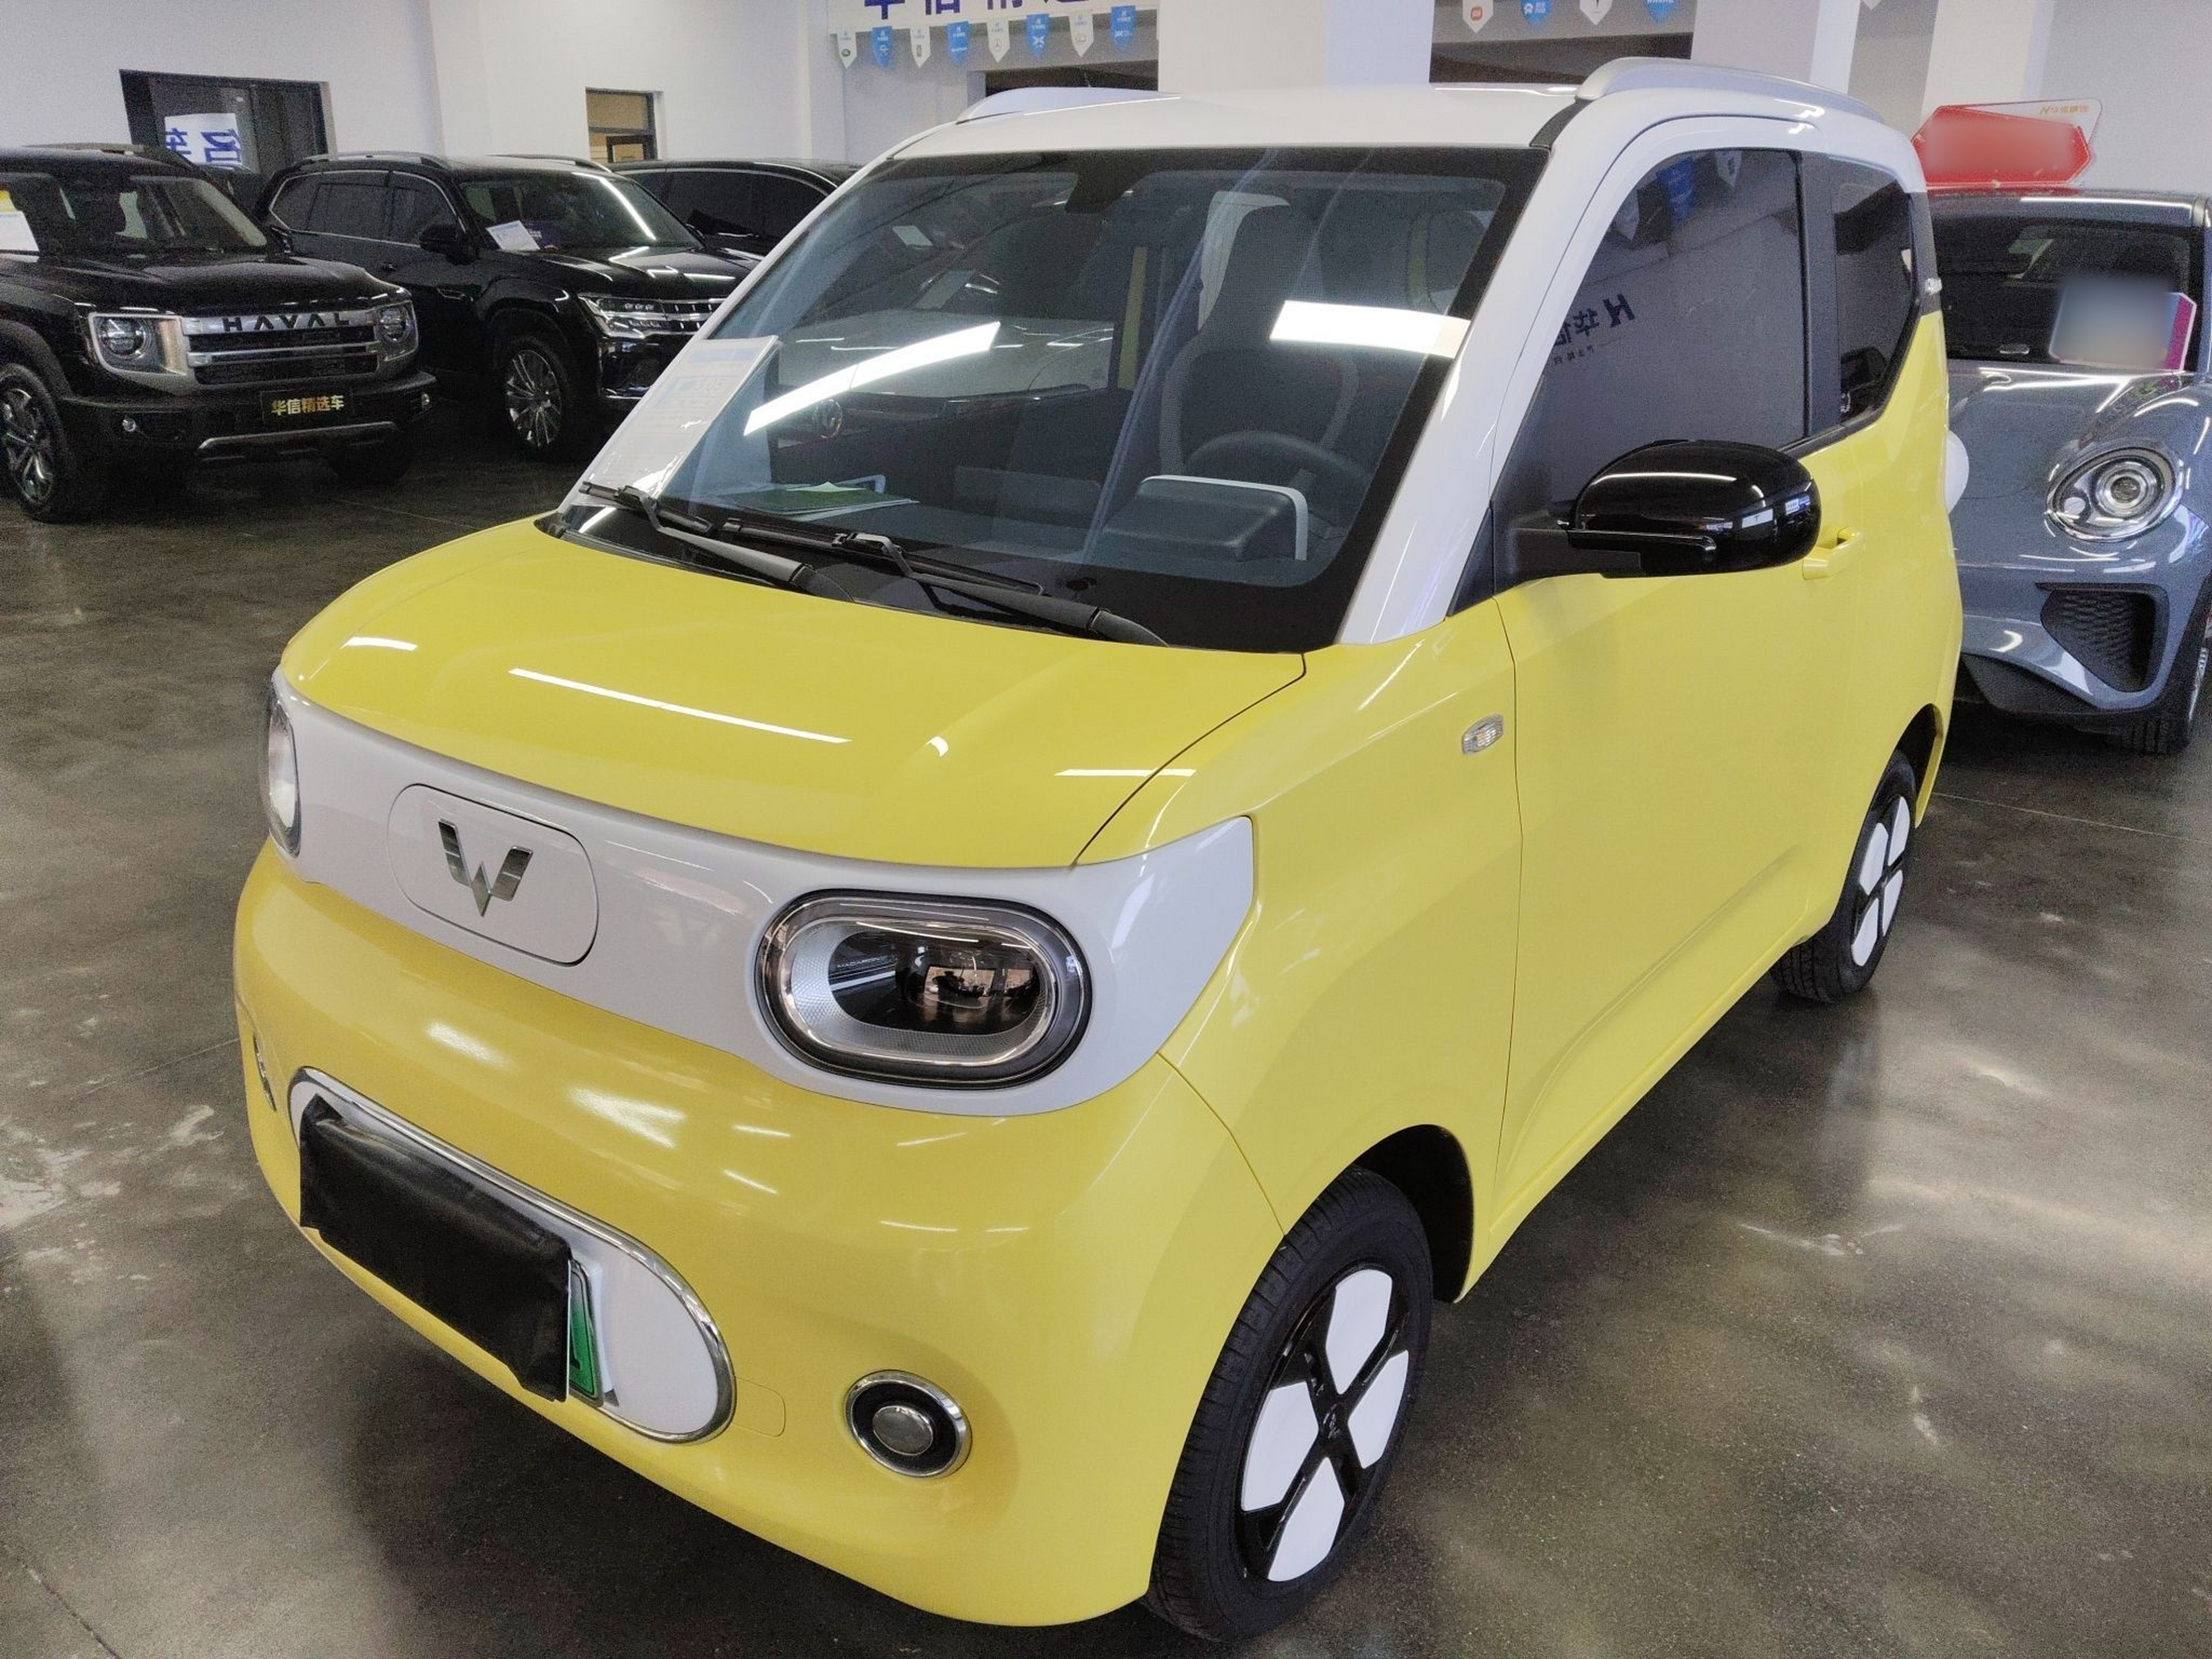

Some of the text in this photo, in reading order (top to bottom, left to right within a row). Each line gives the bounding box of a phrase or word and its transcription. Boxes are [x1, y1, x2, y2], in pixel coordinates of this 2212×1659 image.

[222, 312, 350, 332] HAVAL
[271, 395, 344, 416] 华信精选车
